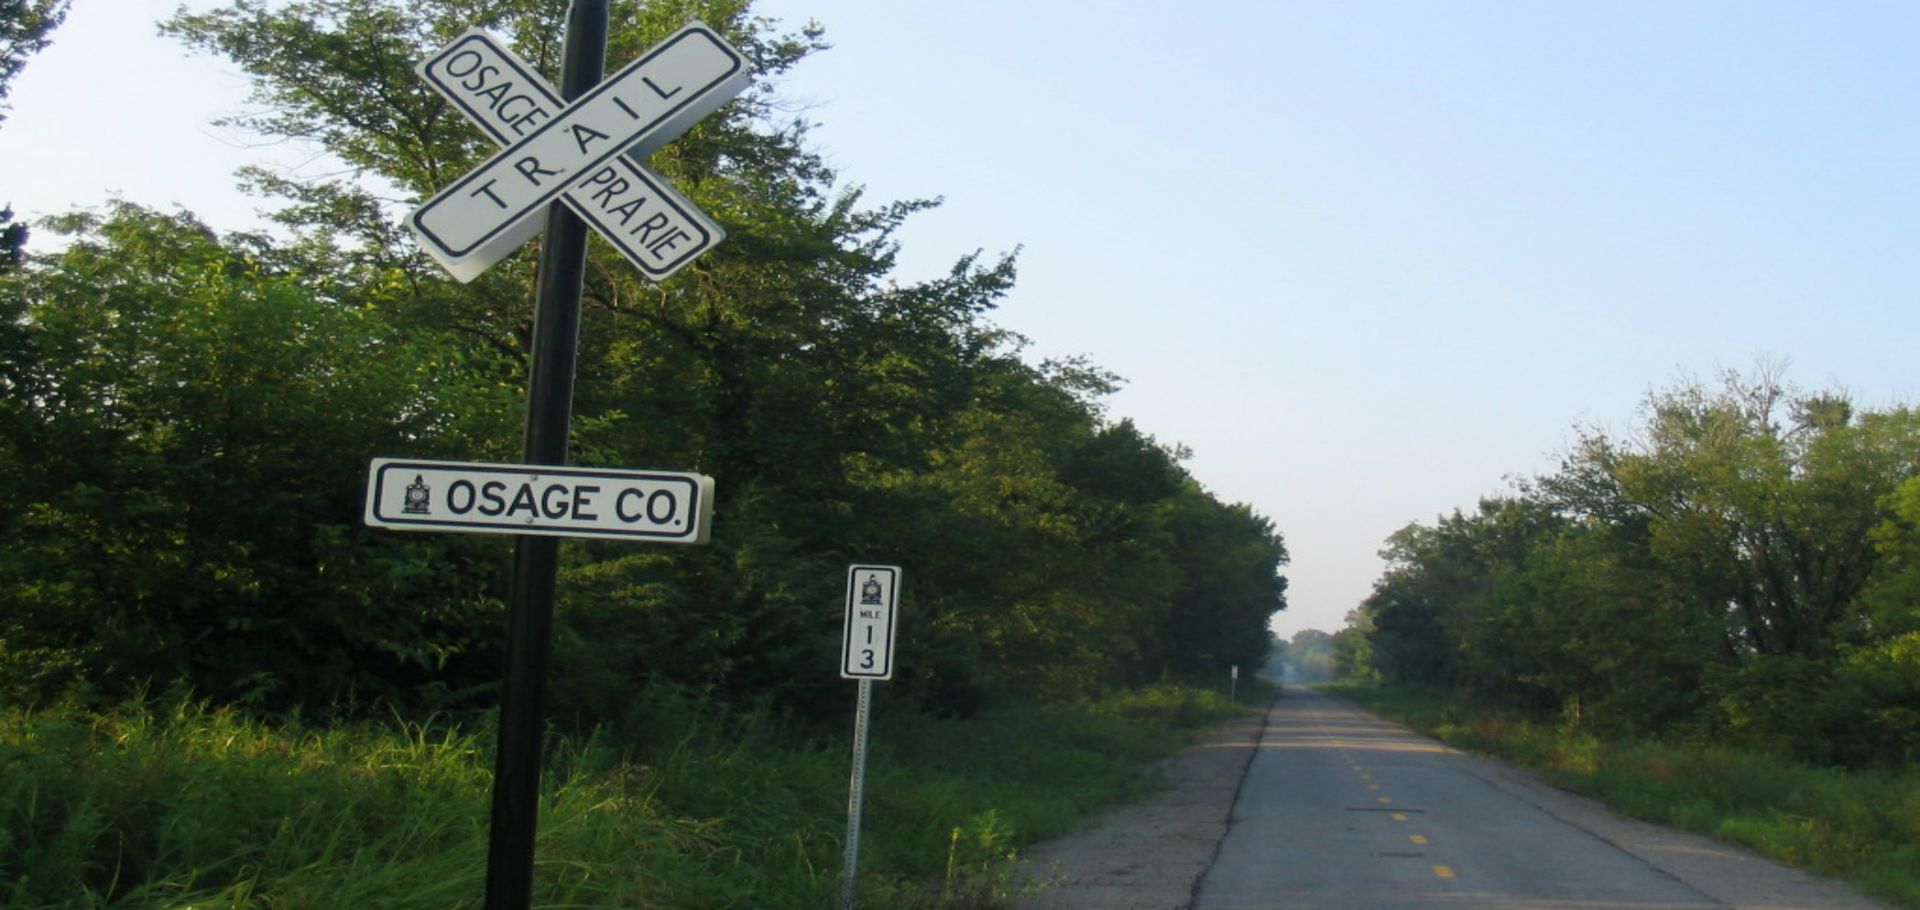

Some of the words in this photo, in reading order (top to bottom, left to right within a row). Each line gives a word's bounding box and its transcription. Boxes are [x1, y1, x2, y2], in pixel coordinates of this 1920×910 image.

[446, 50, 549, 136] OSAGE
[578, 166, 692, 261] PRARIE
[470, 76, 683, 210] TRAIL
[446, 479, 601, 521] OSAGE
[615, 487, 682, 526] CO.
[860, 610, 881, 619] MILE
